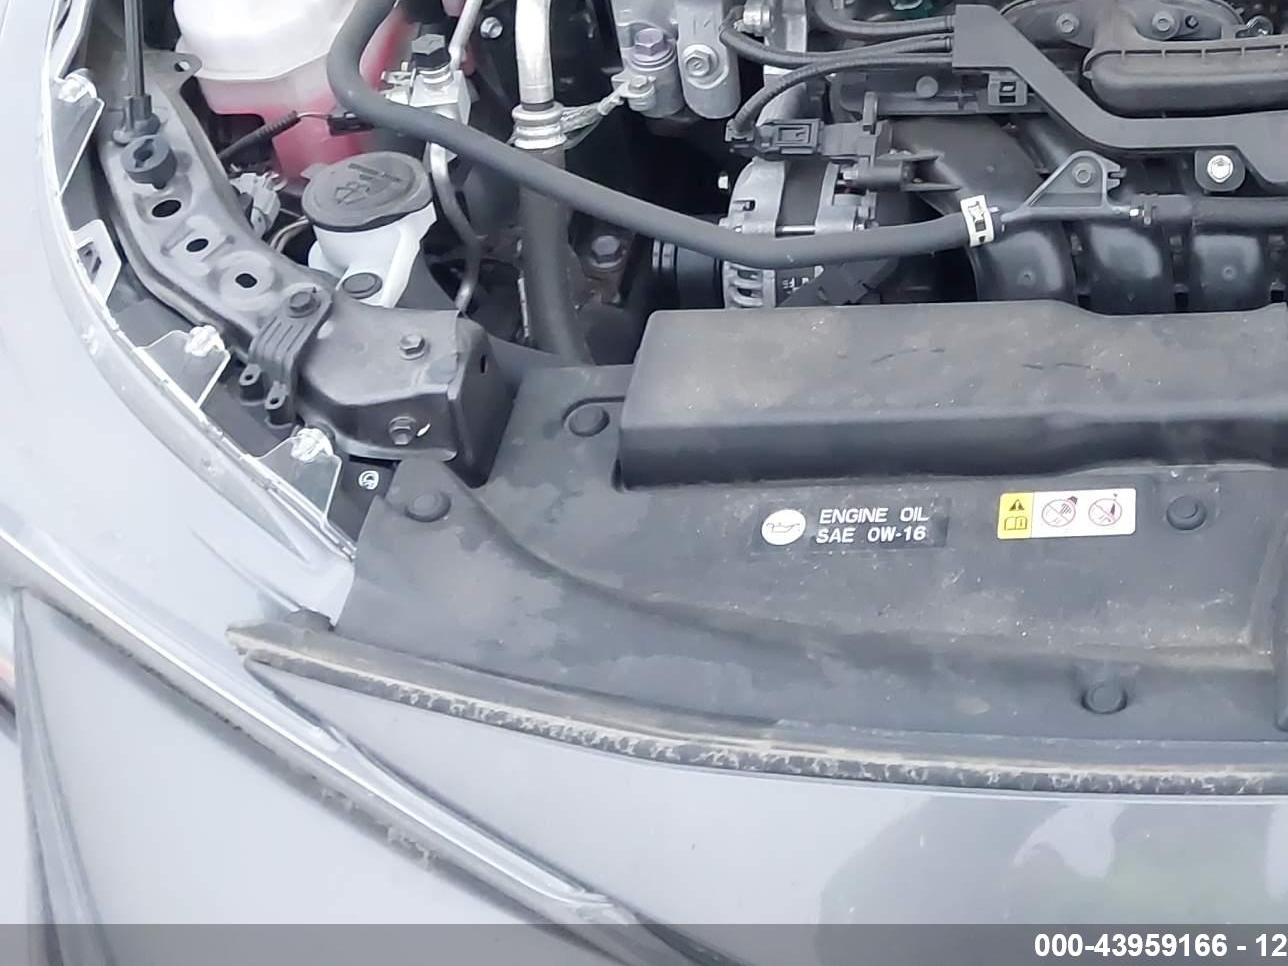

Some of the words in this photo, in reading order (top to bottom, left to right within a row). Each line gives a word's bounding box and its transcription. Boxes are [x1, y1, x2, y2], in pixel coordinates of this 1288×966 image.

[819, 507, 888, 524] ENGINE
[899, 506, 929, 522] OIL
[816, 527, 856, 544] SAE
[867, 525, 927, 542] 0W-16
